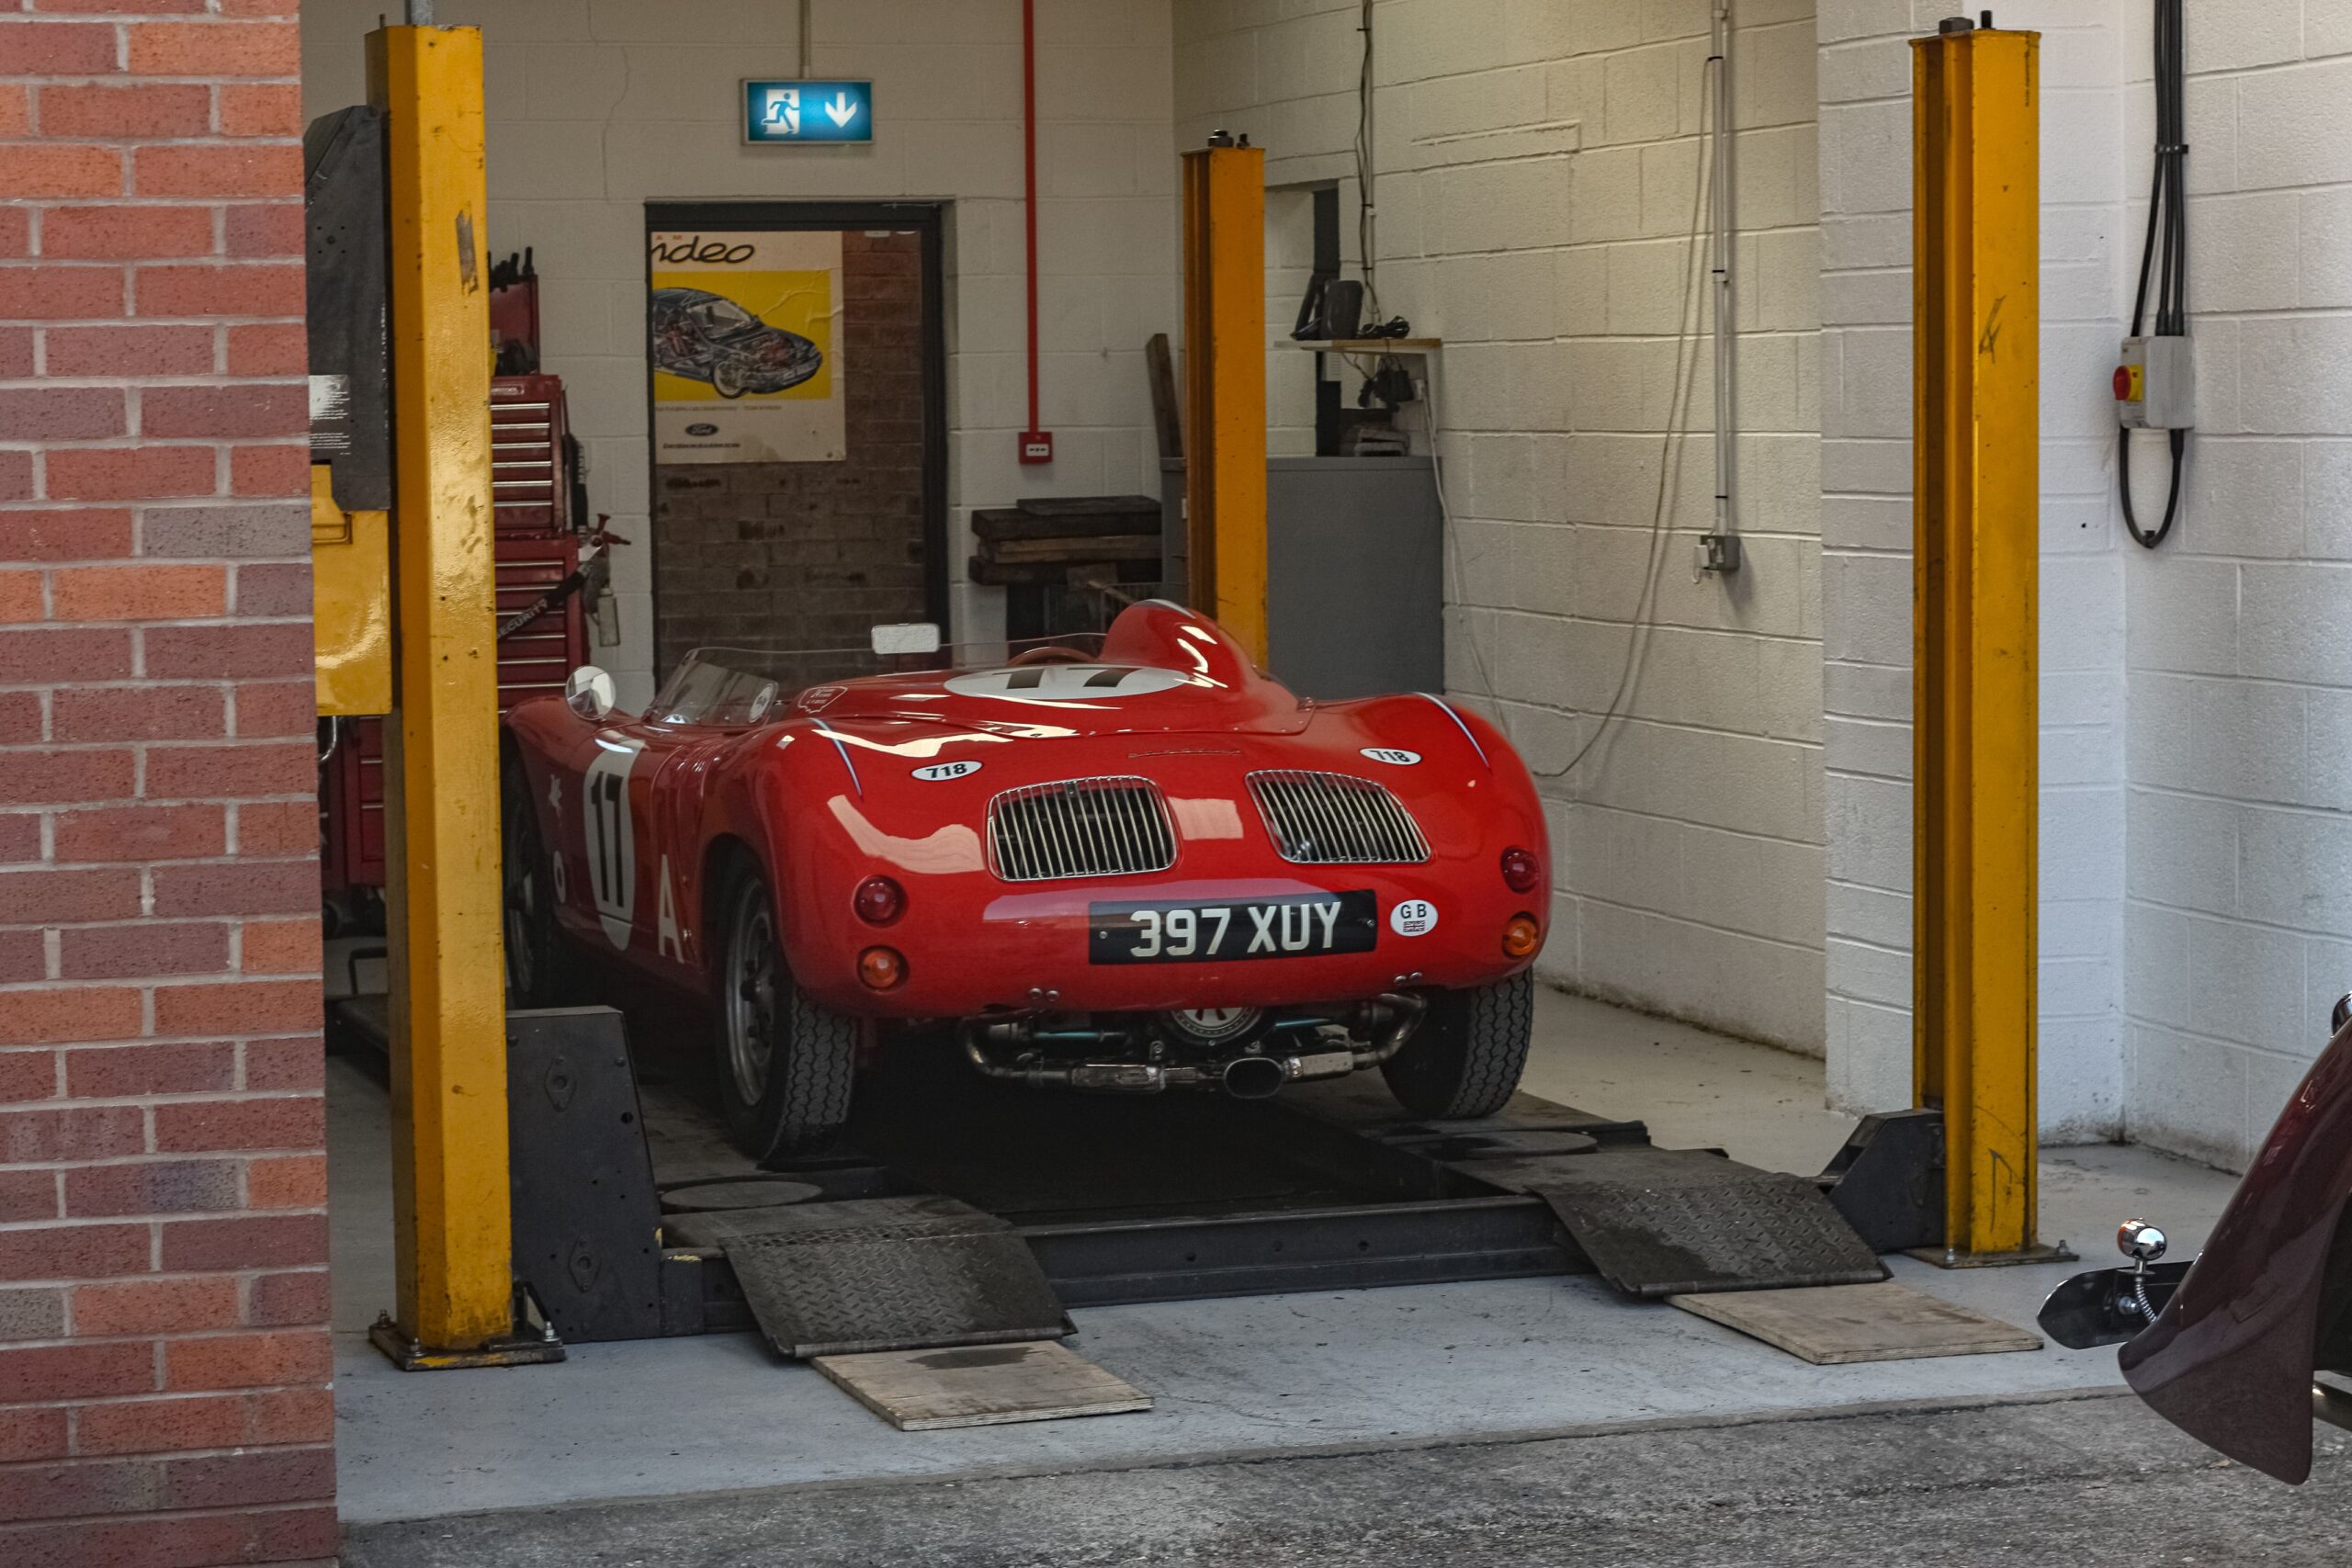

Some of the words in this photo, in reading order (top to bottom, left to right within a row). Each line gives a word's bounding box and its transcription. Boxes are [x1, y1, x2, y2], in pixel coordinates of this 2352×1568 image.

[1368, 750, 1410, 762] 718
[926, 763, 967, 779] 718
[591, 771, 624, 908] 17
[1400, 904, 1427, 919] GB
[1130, 908, 1231, 958] 397
[1247, 901, 1342, 954] XUY
